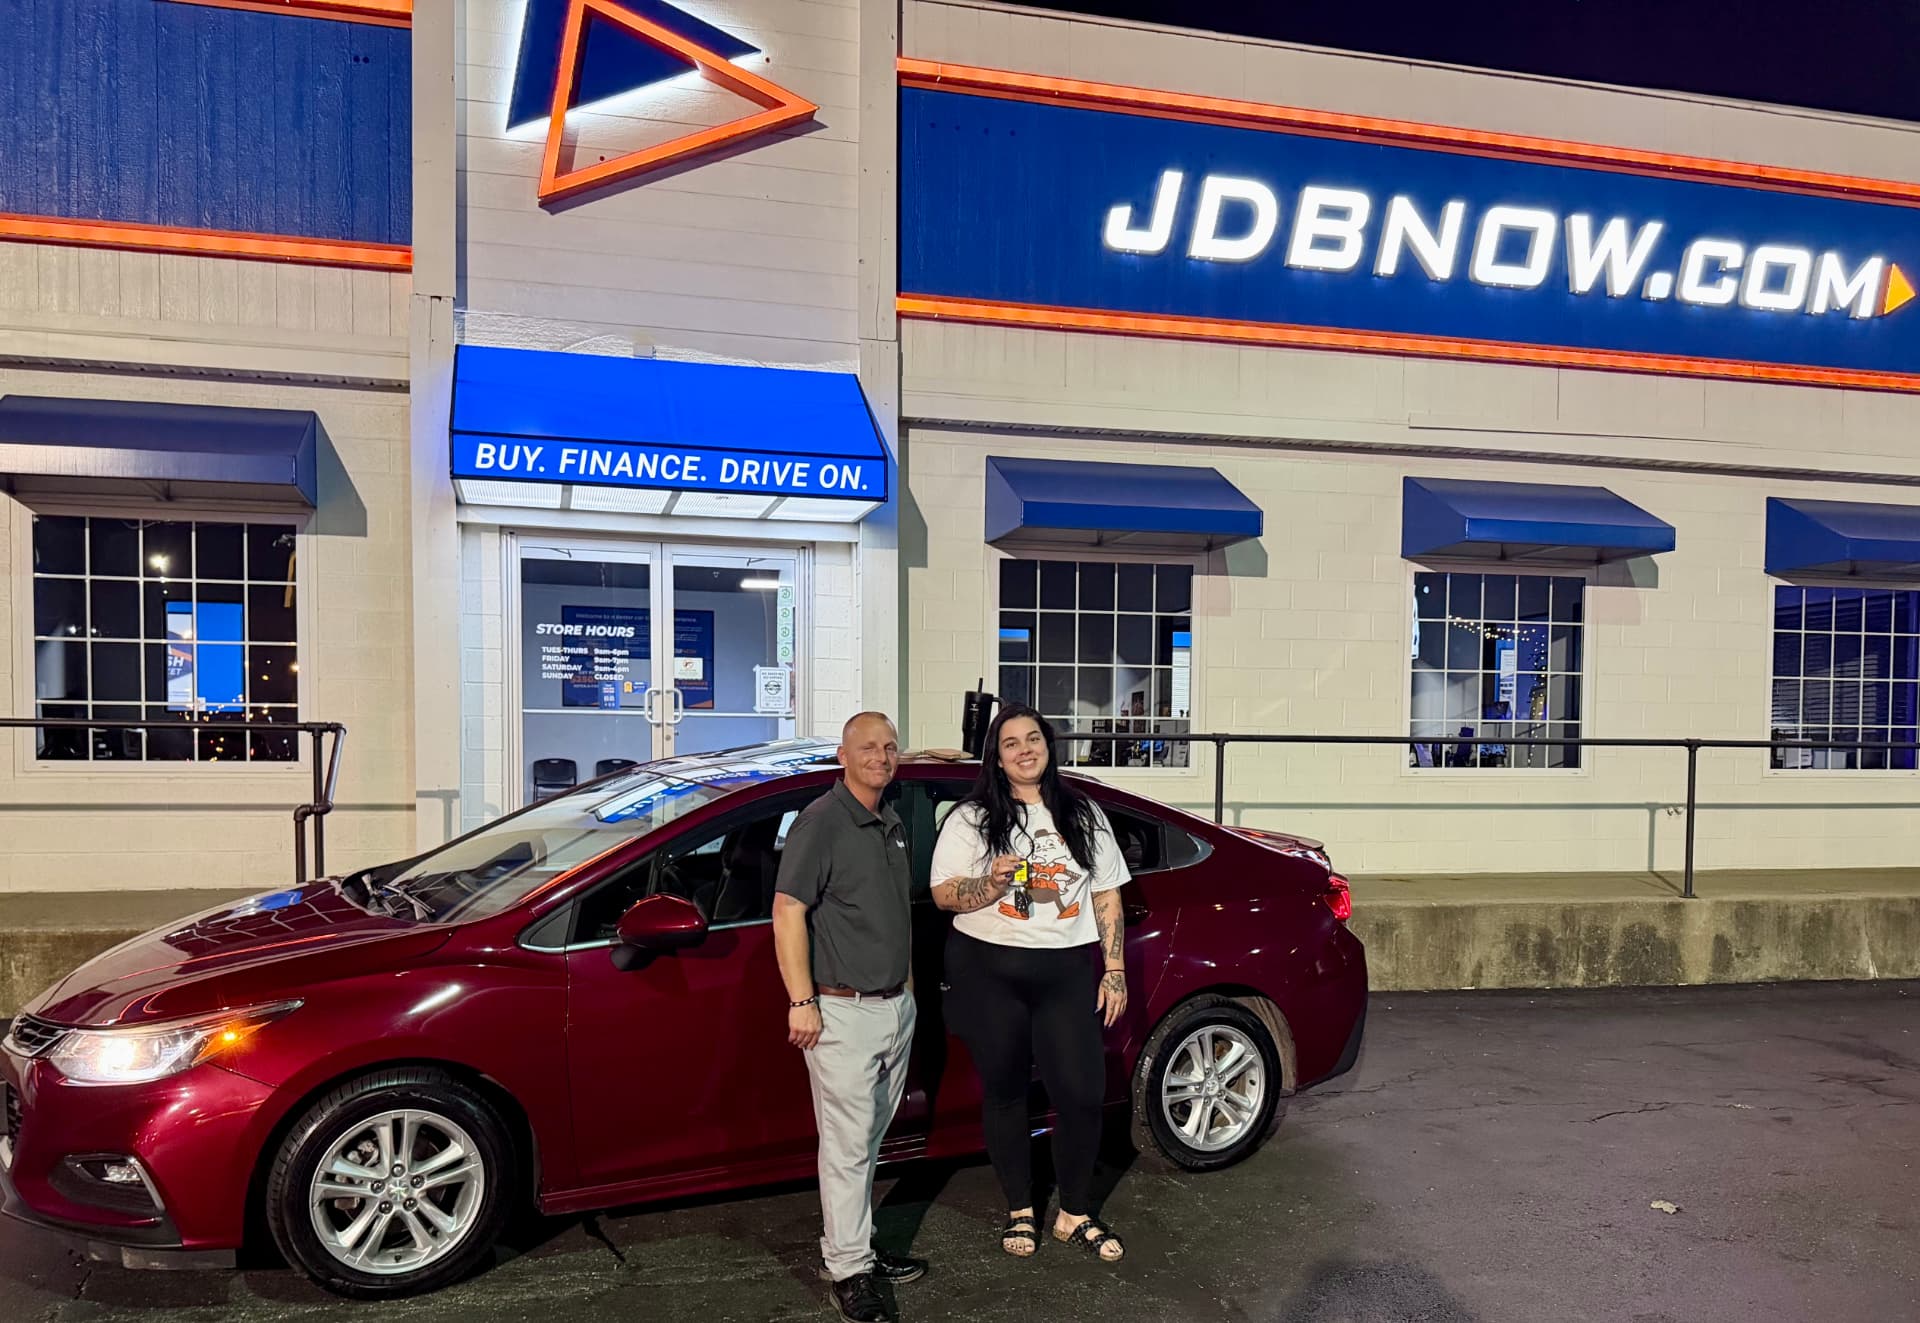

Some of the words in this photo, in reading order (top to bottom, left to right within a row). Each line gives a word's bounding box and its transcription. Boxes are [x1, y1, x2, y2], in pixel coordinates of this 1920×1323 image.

[1103, 169, 1885, 319] JDBNOW.COM
[475, 442, 545, 473] BUY.
[559, 448, 707, 482] FINANCE.
[719, 458, 811, 488] DRIVE
[818, 463, 869, 491] ON.
[536, 623, 583, 636] STORE
[585, 625, 635, 637] HOURS
[541, 646, 589, 655] TUES-THURS
[542, 663, 583, 671] SATURDAY
[542, 672, 574, 680] SUNDAY
[594, 673, 625, 681] CLOSED
